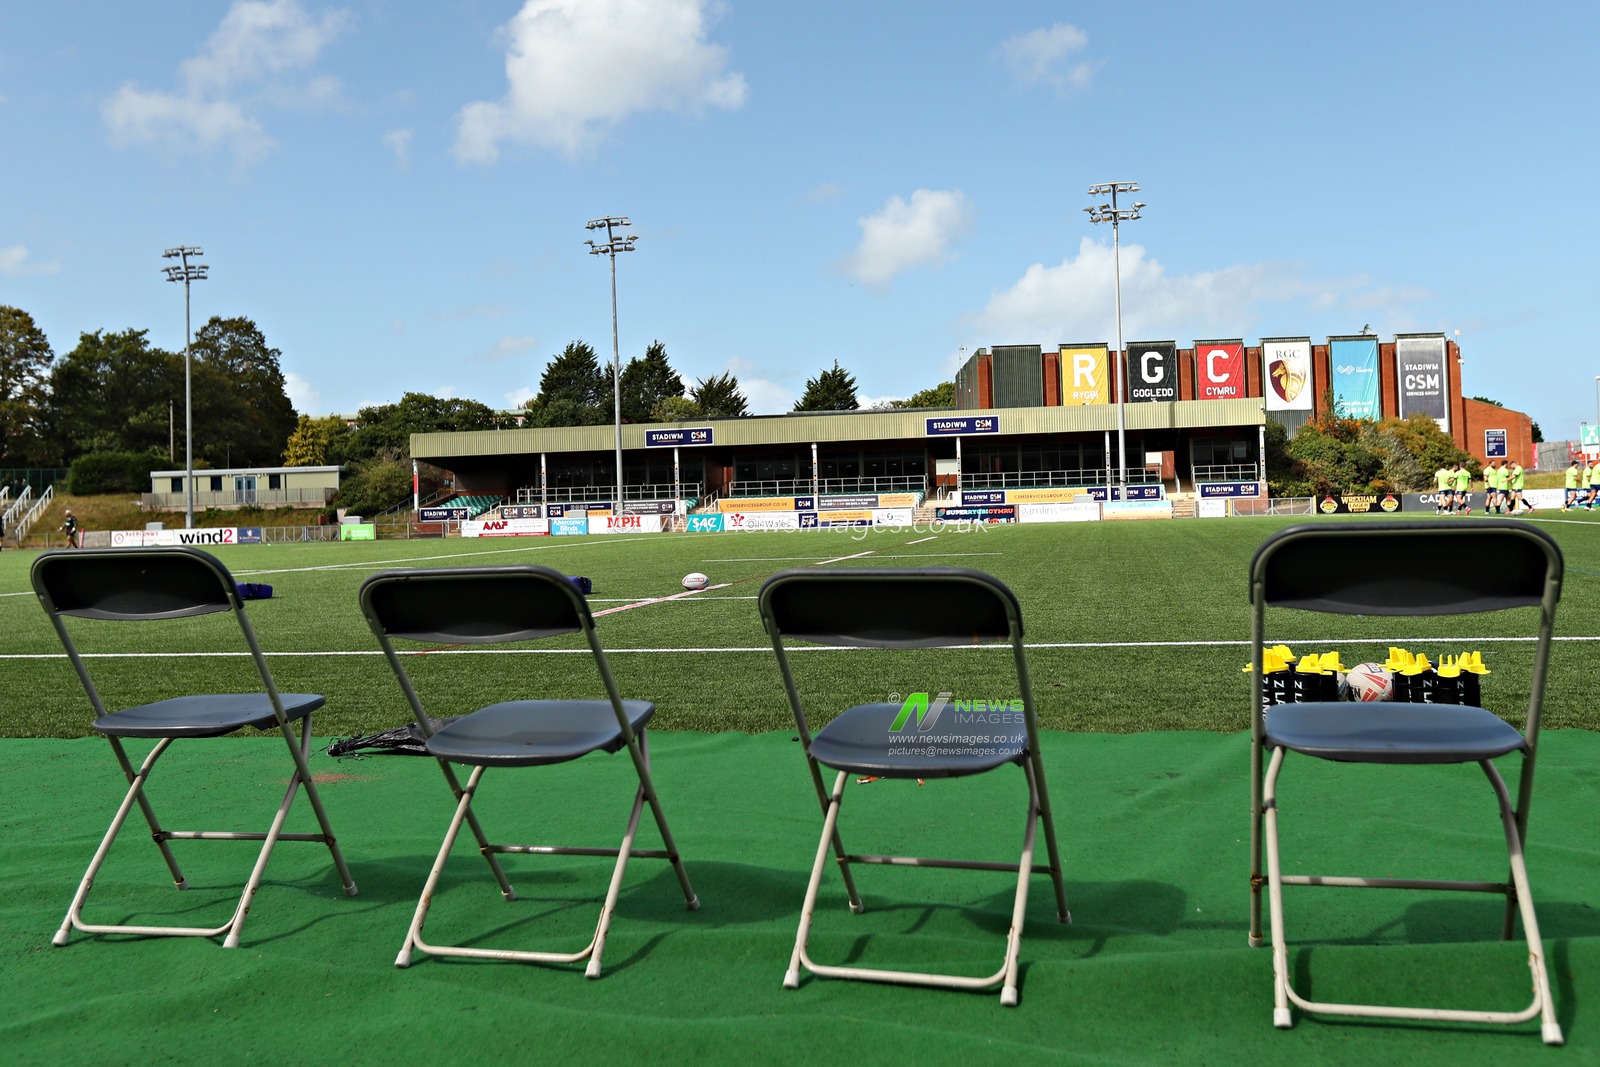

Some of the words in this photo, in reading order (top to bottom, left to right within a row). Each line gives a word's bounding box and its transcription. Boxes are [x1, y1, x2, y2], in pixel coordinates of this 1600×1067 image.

[1276, 349, 1300, 359] RGC
[1073, 354, 1096, 387] R
[1141, 351, 1164, 384] G
[1206, 349, 1230, 383] C
[1405, 363, 1439, 371] STADIWM
[1405, 374, 1439, 390] CSM
[1073, 391, 1099, 399] RYGBI
[1133, 388, 1174, 398] GOGLEDD
[1206, 386, 1236, 395] CYMRU
[933, 421, 967, 429] STADIWM
[975, 420, 992, 428] CSM
[652, 433, 684, 441] STADIWM
[691, 431, 707, 439] CSM
[1341, 496, 1377, 504] WREXHAM
[1021, 506, 1058, 518] gamlins
[607, 516, 641, 528] MPH
[692, 518, 716, 528] SAC
[180, 529, 233, 544] wind2
